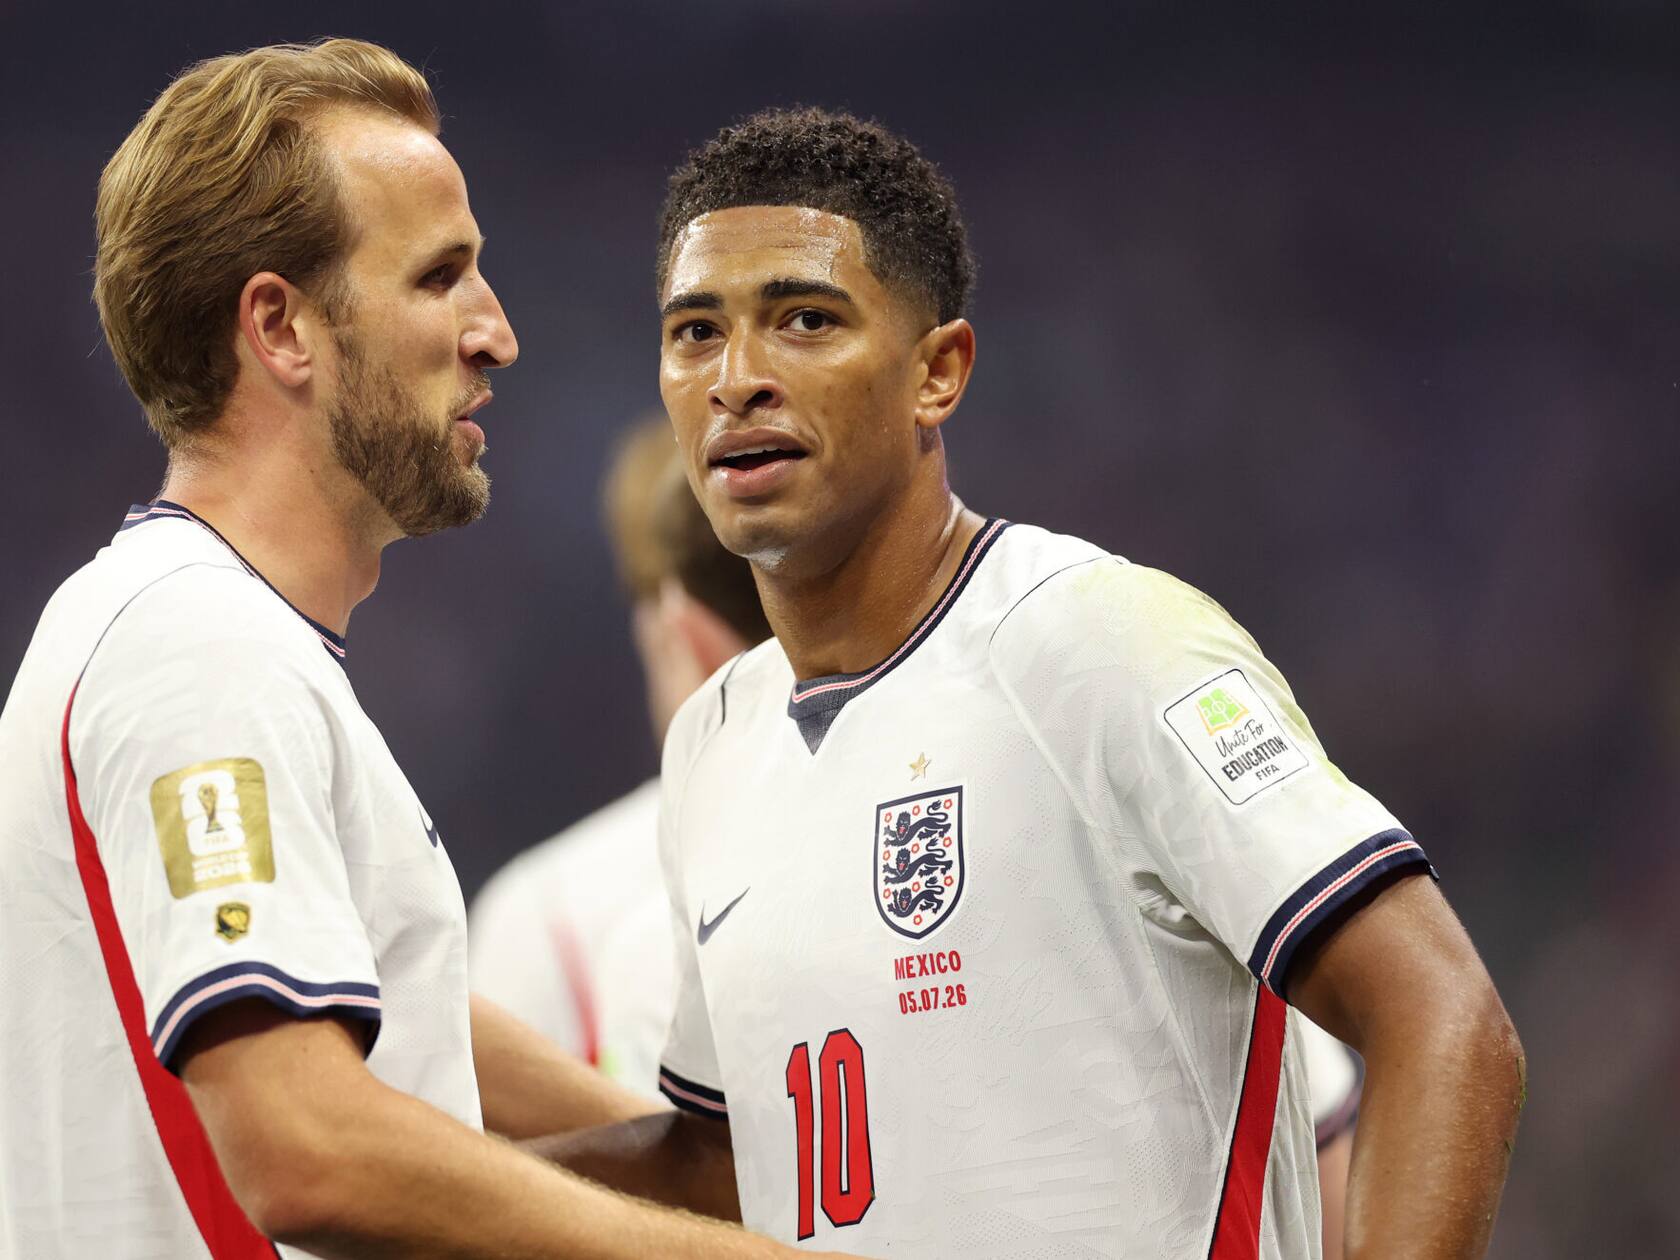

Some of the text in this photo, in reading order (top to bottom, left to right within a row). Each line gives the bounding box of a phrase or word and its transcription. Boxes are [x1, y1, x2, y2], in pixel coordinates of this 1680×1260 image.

[1215, 718, 1265, 758] Unite For
[1221, 736, 1289, 782] EDUCATION
[1255, 764, 1280, 781] FIFA
[894, 950, 962, 981] MEXICO
[898, 984, 967, 1015] 05.07.26
[786, 1027, 876, 1242] 10
